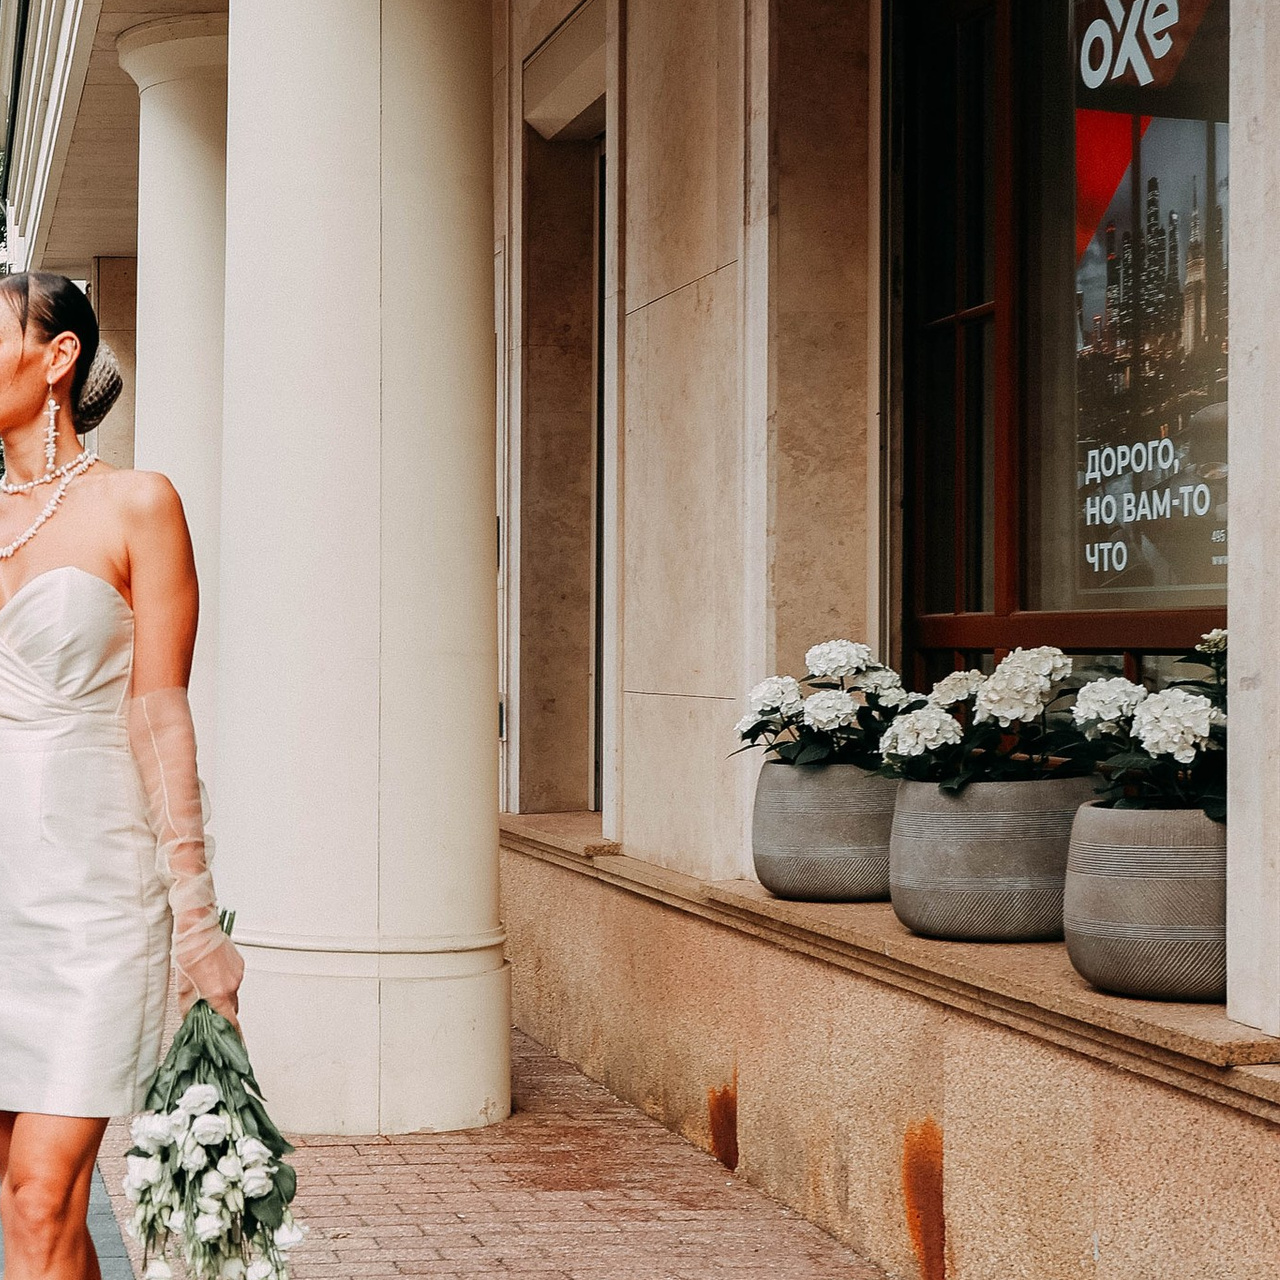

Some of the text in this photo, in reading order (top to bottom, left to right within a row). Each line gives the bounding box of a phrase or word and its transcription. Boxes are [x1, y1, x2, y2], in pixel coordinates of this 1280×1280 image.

[1085, 438, 1180, 485] ДОРОГО,
[1086, 483, 1211, 526] НО ВАМ-ТО
[1085, 541, 1128, 572] ЧТО
